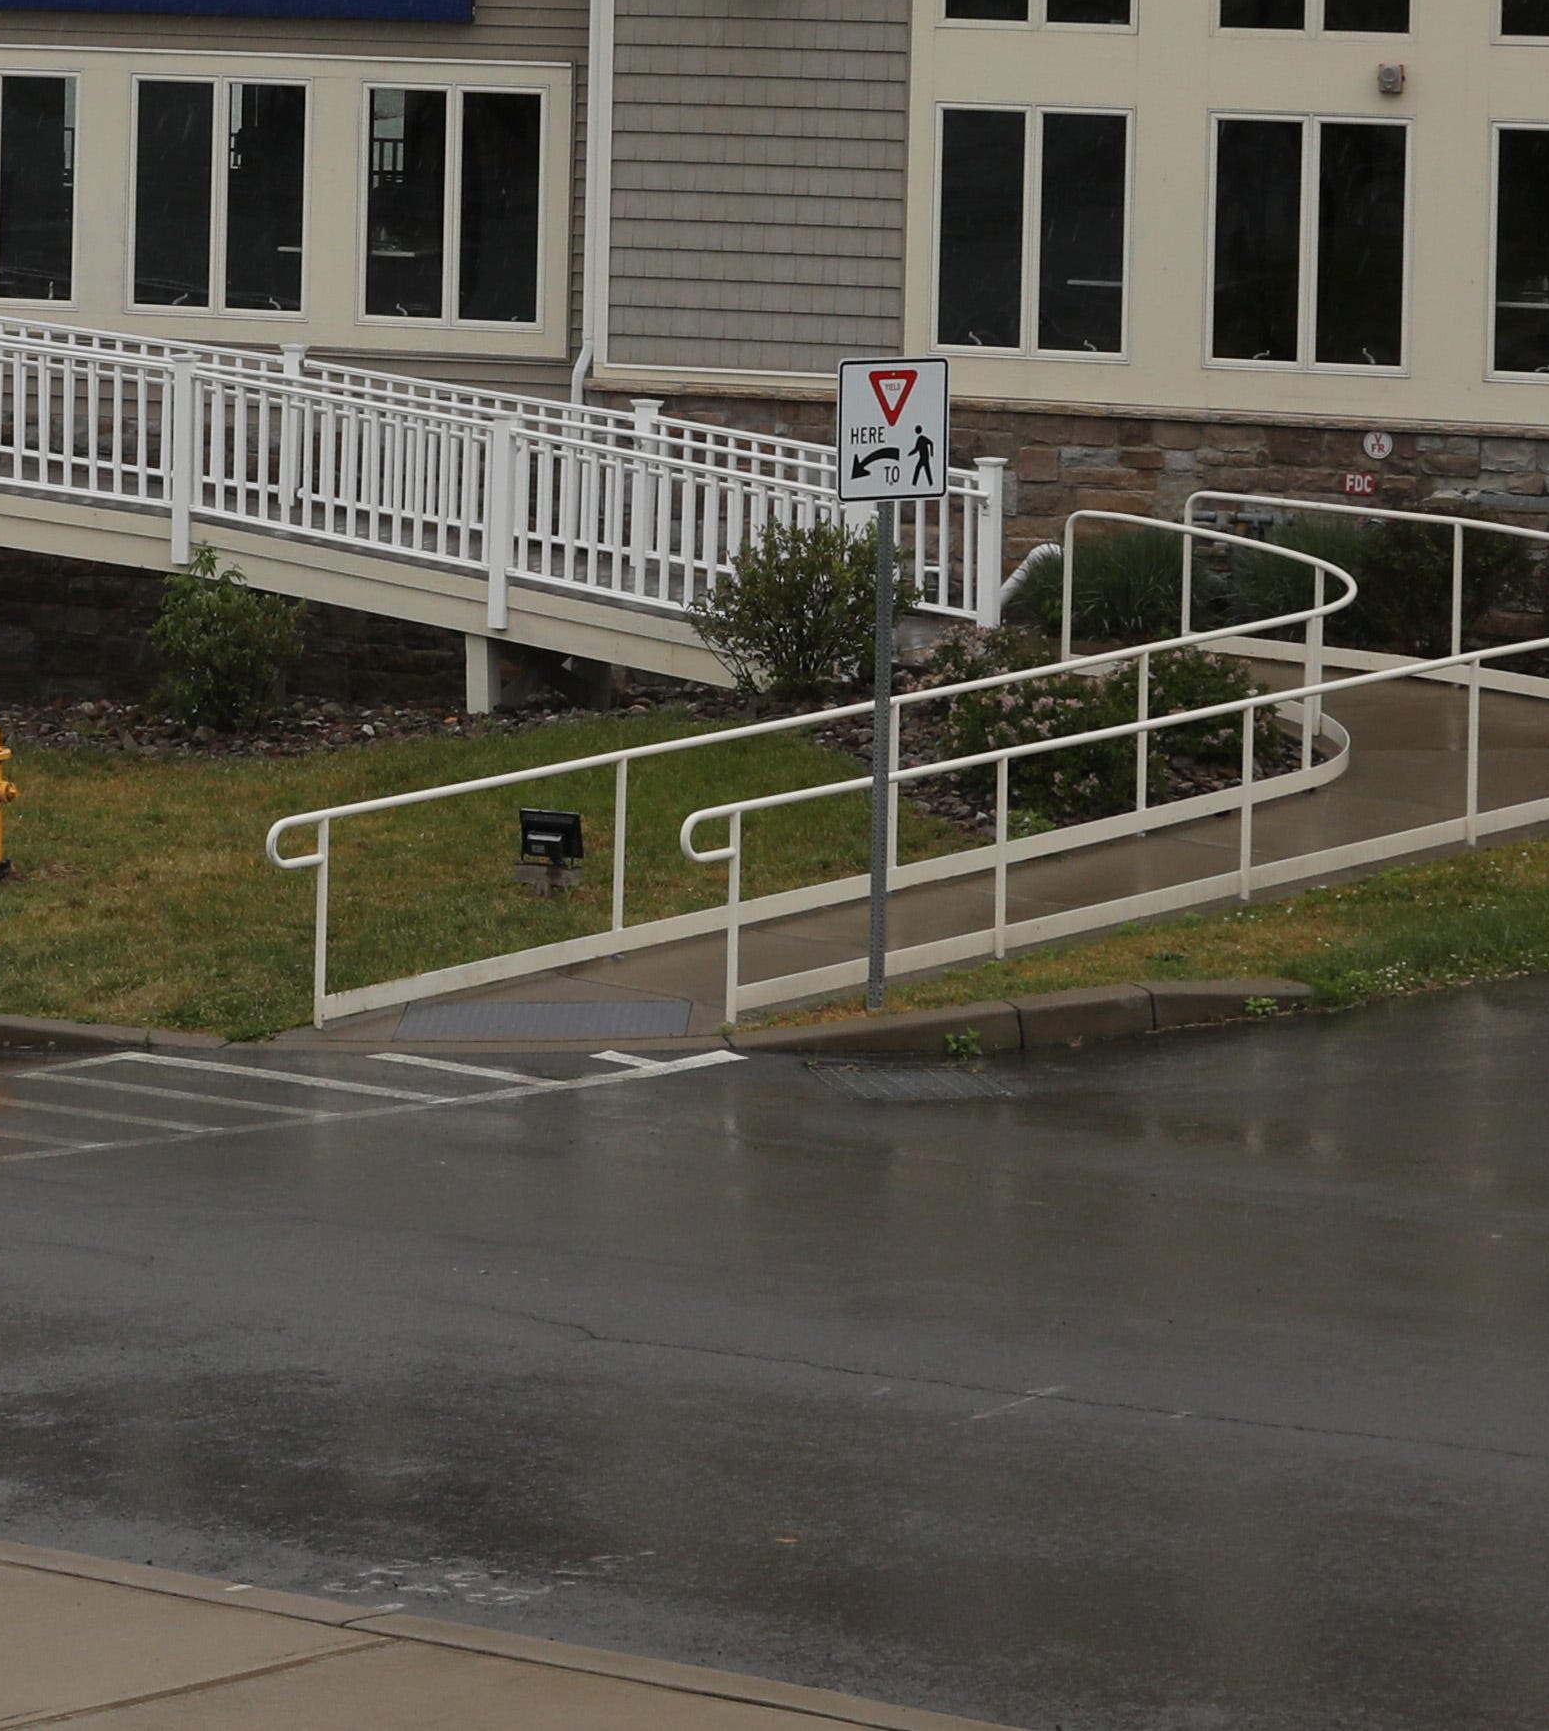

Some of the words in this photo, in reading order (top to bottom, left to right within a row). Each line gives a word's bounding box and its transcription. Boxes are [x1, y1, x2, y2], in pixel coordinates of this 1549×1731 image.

[885, 383, 901, 391] YIELD
[850, 426, 886, 445] HERE
[1371, 443, 1385, 453] FR
[884, 465, 900, 483] TO
[1346, 473, 1373, 492] FDC
